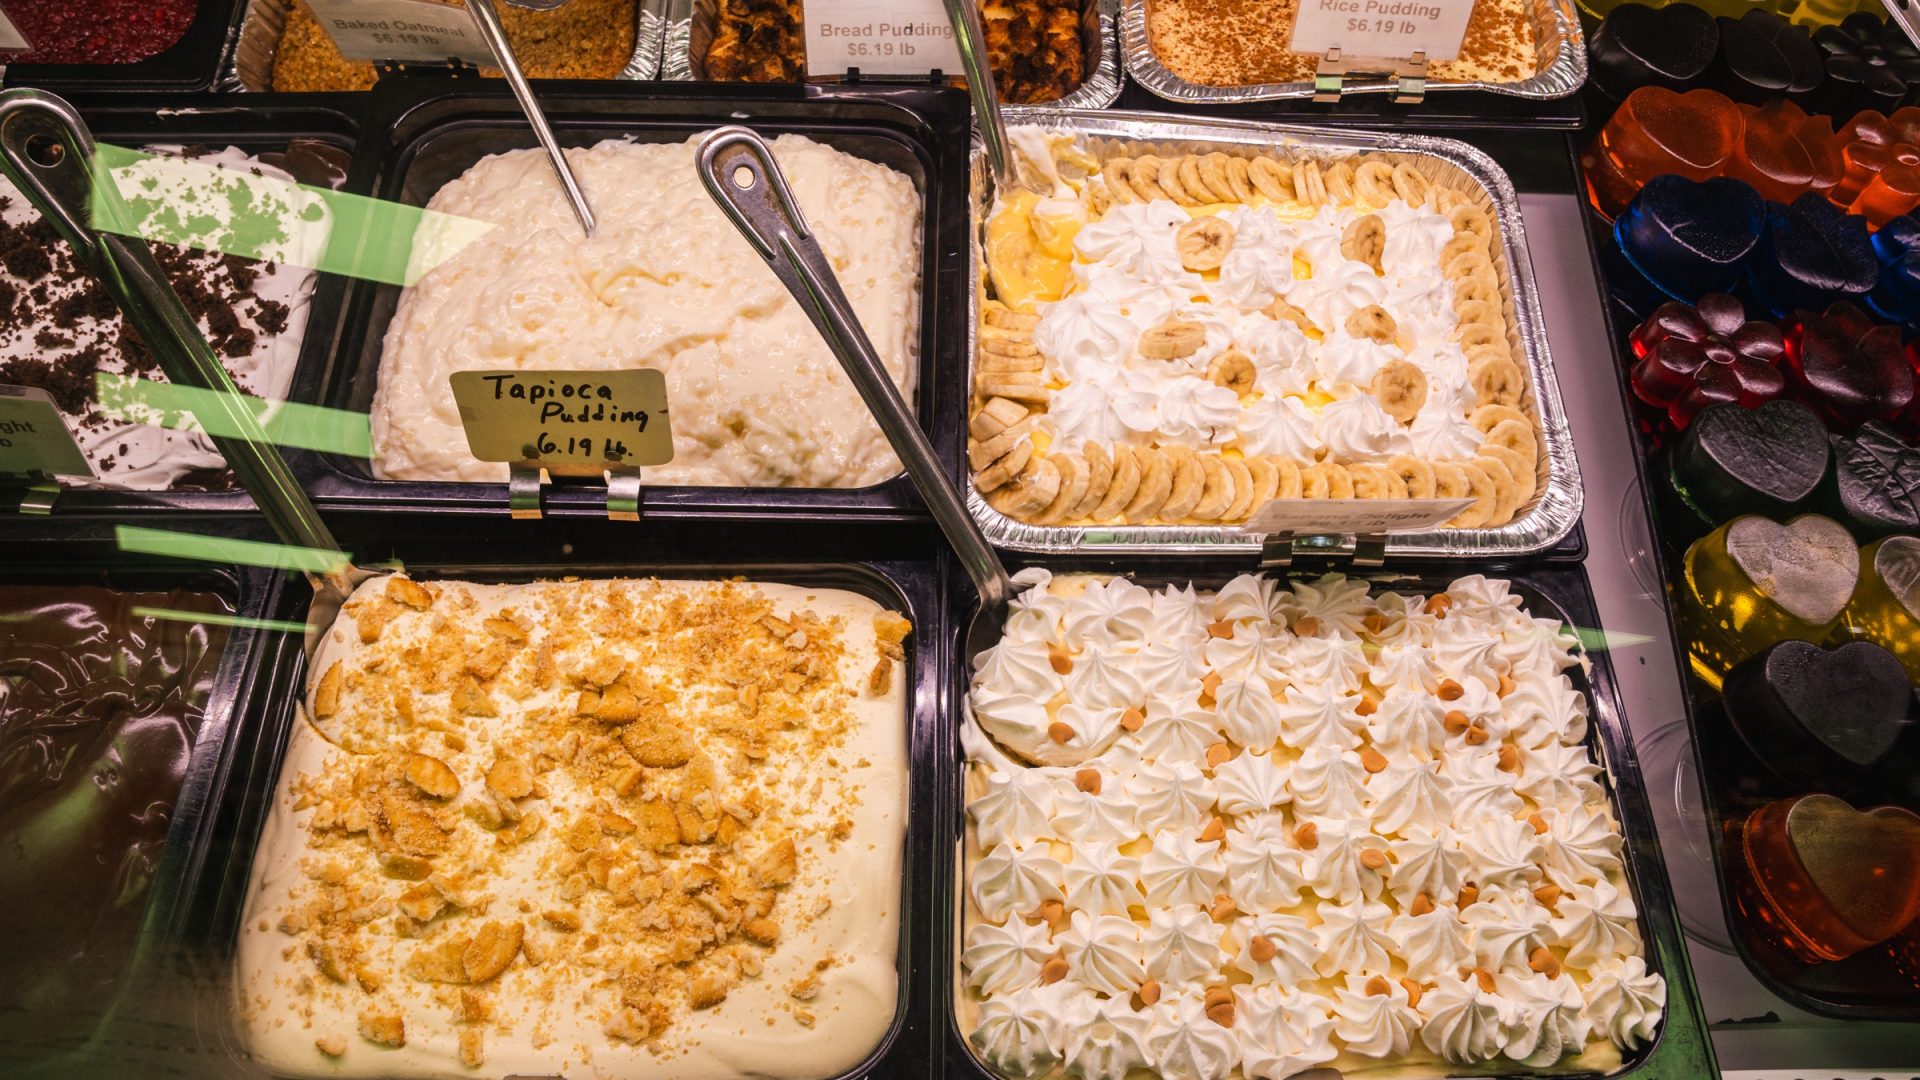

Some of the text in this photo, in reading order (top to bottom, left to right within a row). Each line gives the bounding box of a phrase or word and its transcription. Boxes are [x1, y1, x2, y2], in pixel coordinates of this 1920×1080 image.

[1319, 0, 1442, 20] Rice Pudding
[333, 19, 466, 38] Baked Oatmeal
[820, 23, 954, 39] Bread Pudding
[1347, 18, 1416, 34] $6.19 lb
[372, 32, 440, 45] $6.19 lb
[847, 42, 916, 56] $6.19 lb
[482, 374, 613, 404] Tapioca
[540, 401, 649, 433] Pudding
[537, 432, 592, 457] 6.19
[1358, 512, 1432, 521] Delight
